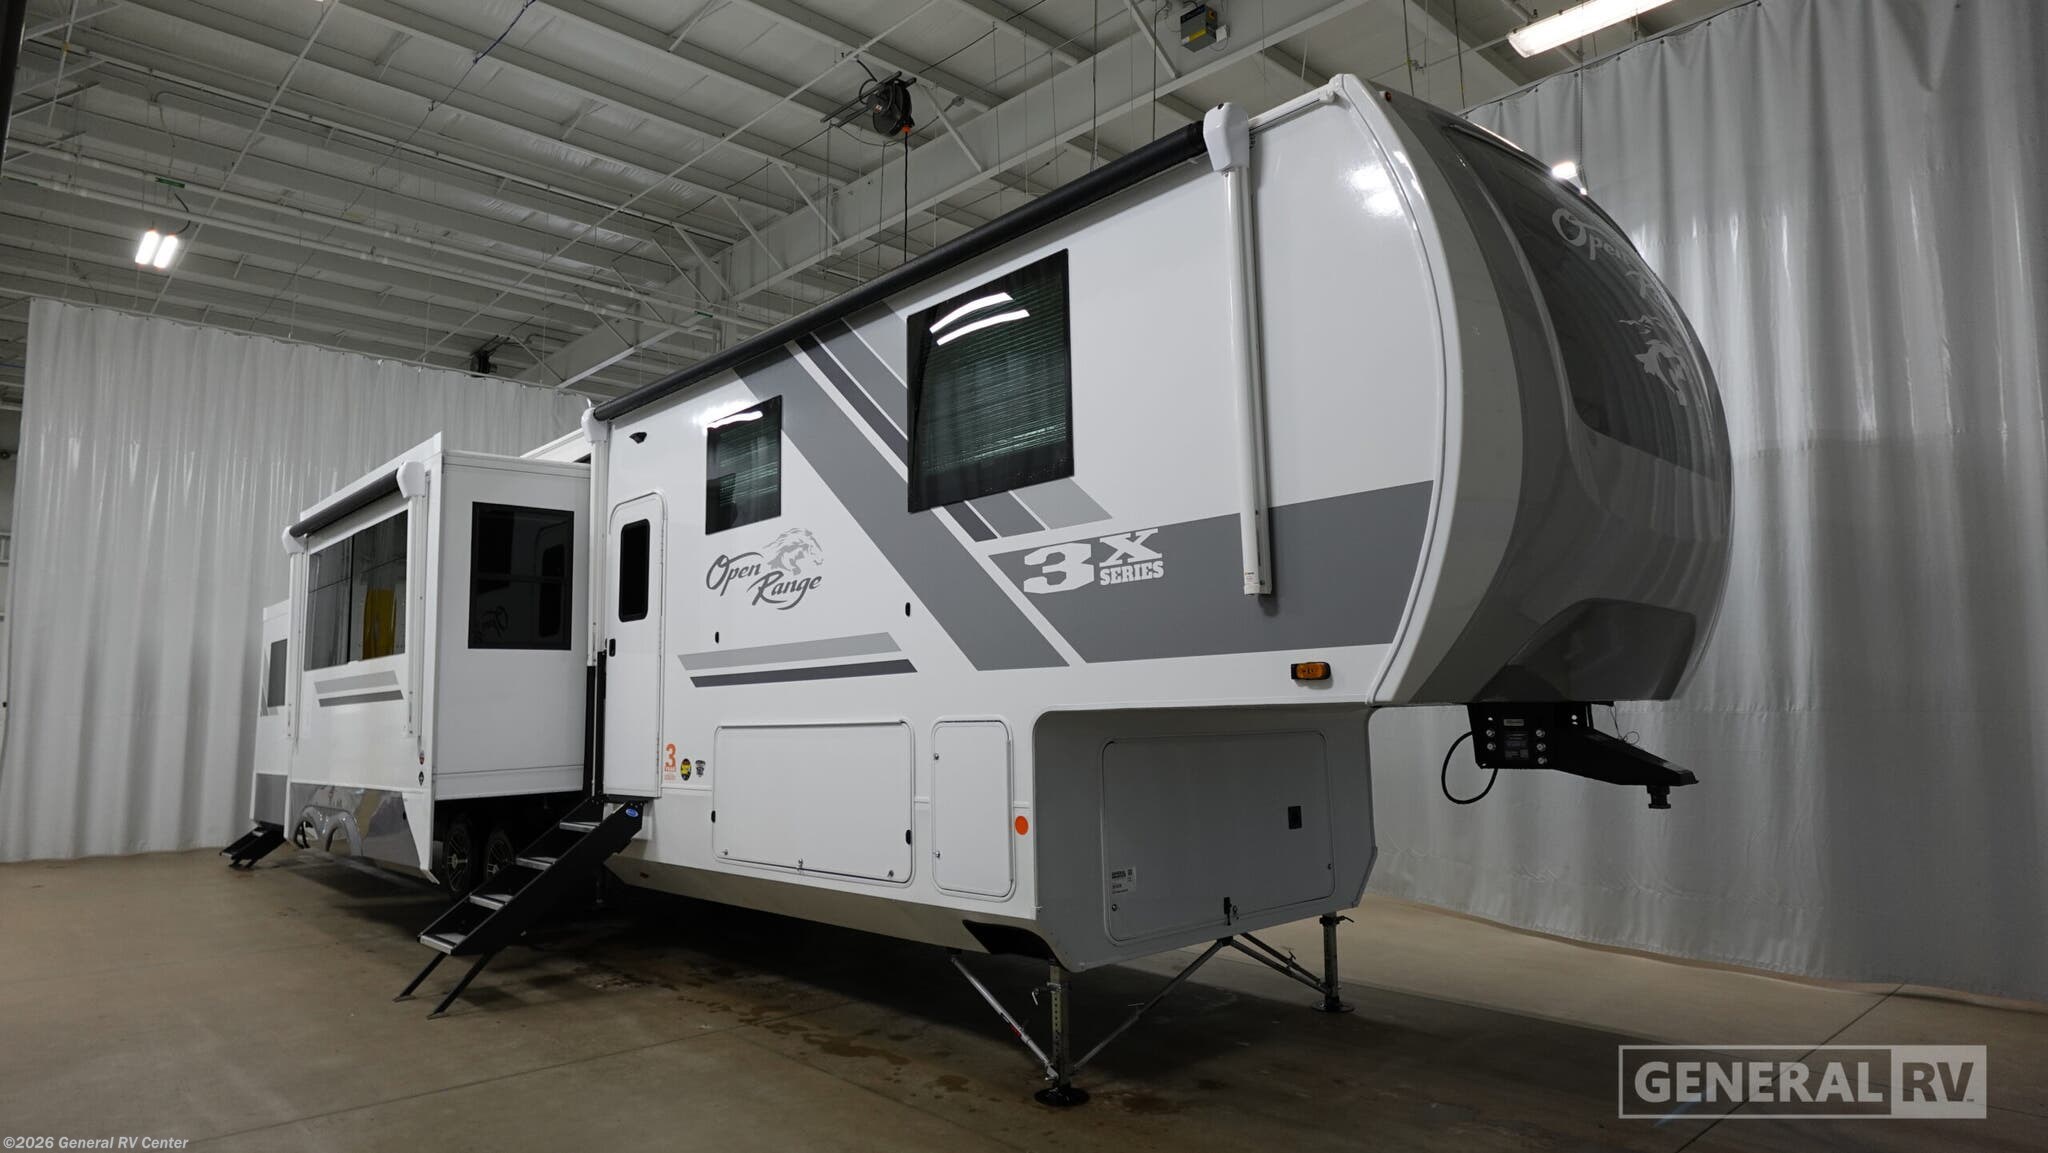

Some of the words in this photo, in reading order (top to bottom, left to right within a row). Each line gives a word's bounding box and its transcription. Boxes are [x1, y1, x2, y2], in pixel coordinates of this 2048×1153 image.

[706, 552, 764, 596] Open
[1099, 561, 1164, 585] SERIES
[746, 571, 822, 610] Range
[665, 743, 676, 768] 3
